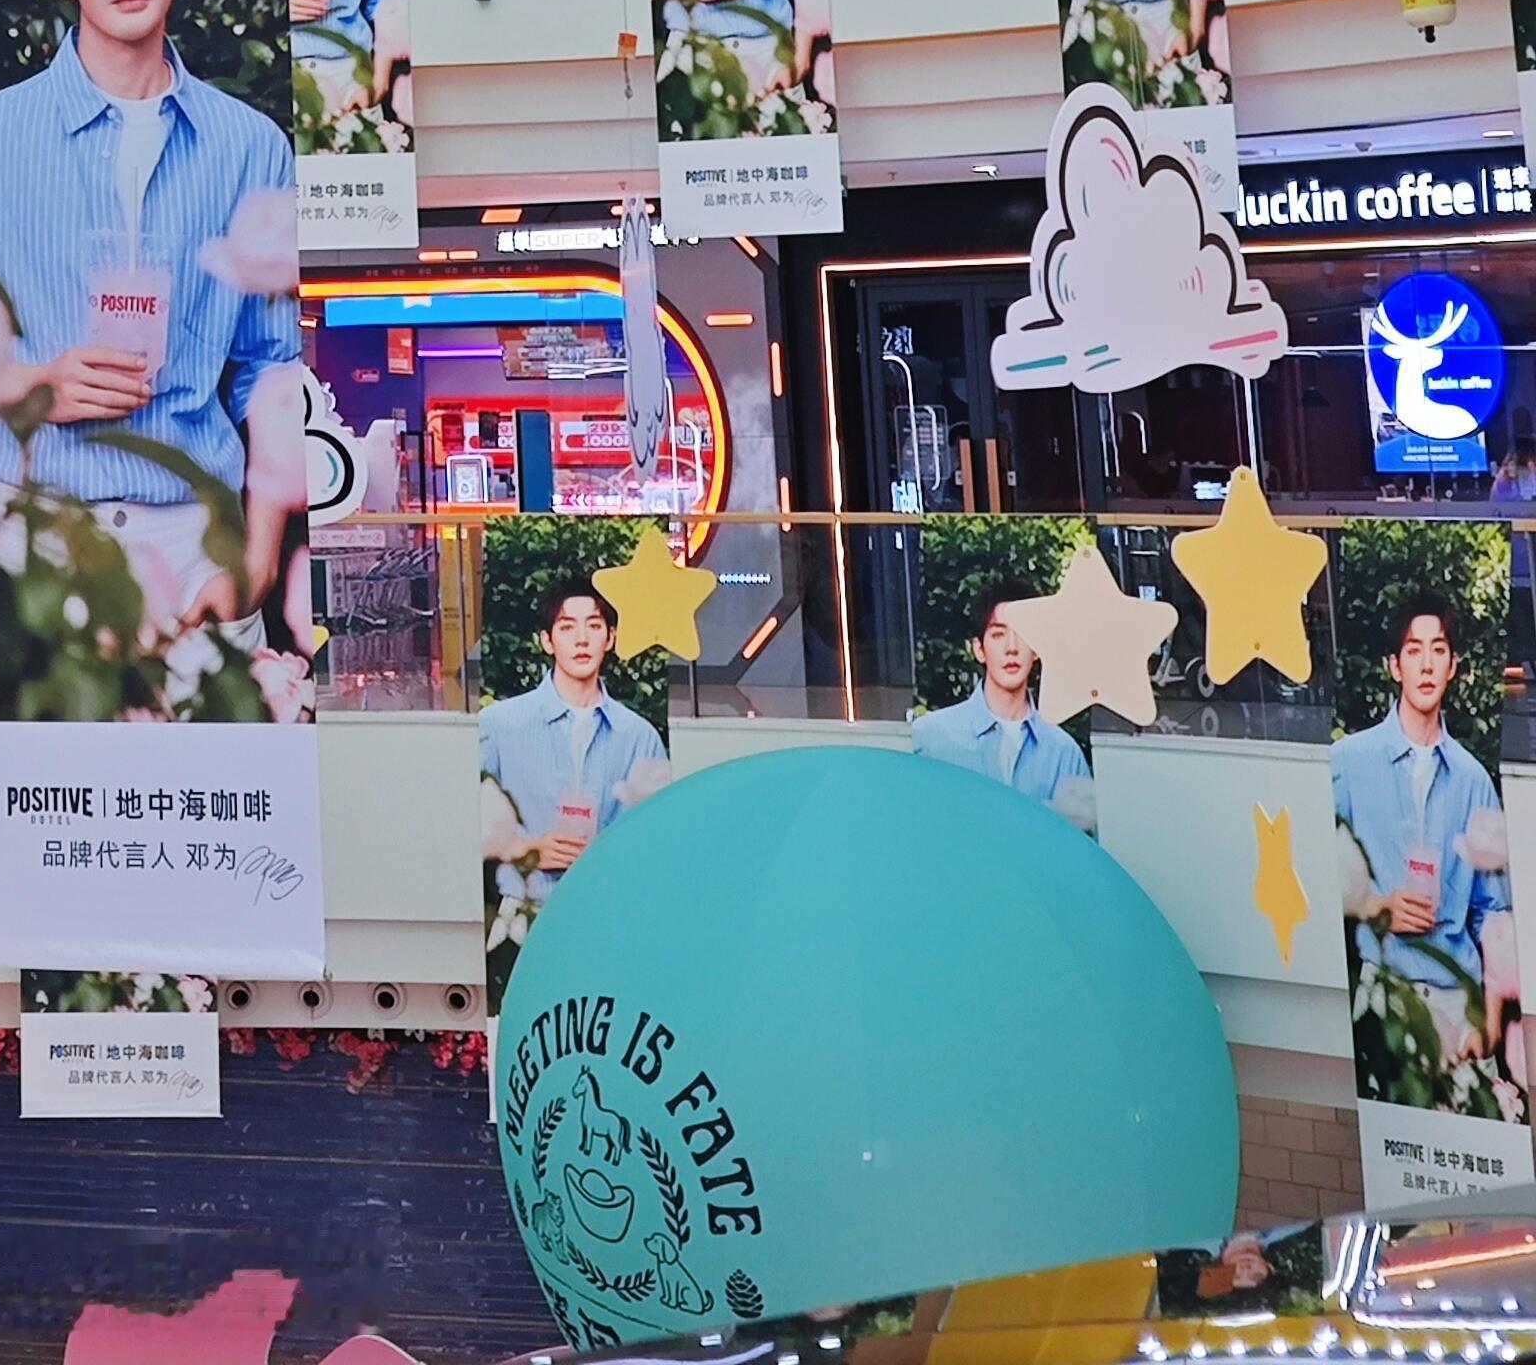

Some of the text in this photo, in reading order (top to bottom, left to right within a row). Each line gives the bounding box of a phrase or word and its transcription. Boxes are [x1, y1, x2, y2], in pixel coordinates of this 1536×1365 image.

[686, 166, 808, 185] POSITIVE 地中海咖啡
[1236, 169, 1475, 226] luckin coffee
[296, 207, 338, 220] 代言人
[534, 231, 600, 249] SUPER
[101, 294, 156, 315] POSITIVE
[7, 786, 271, 823] POSITIVE 地中海咖啡
[43, 839, 236, 871] 品牌代言人 邓为
[50, 1045, 185, 1060] POSITIVE 地中海咖啡
[68, 1070, 136, 1084] 品牌代言人
[505, 995, 762, 1238] MEETING IS FATE
